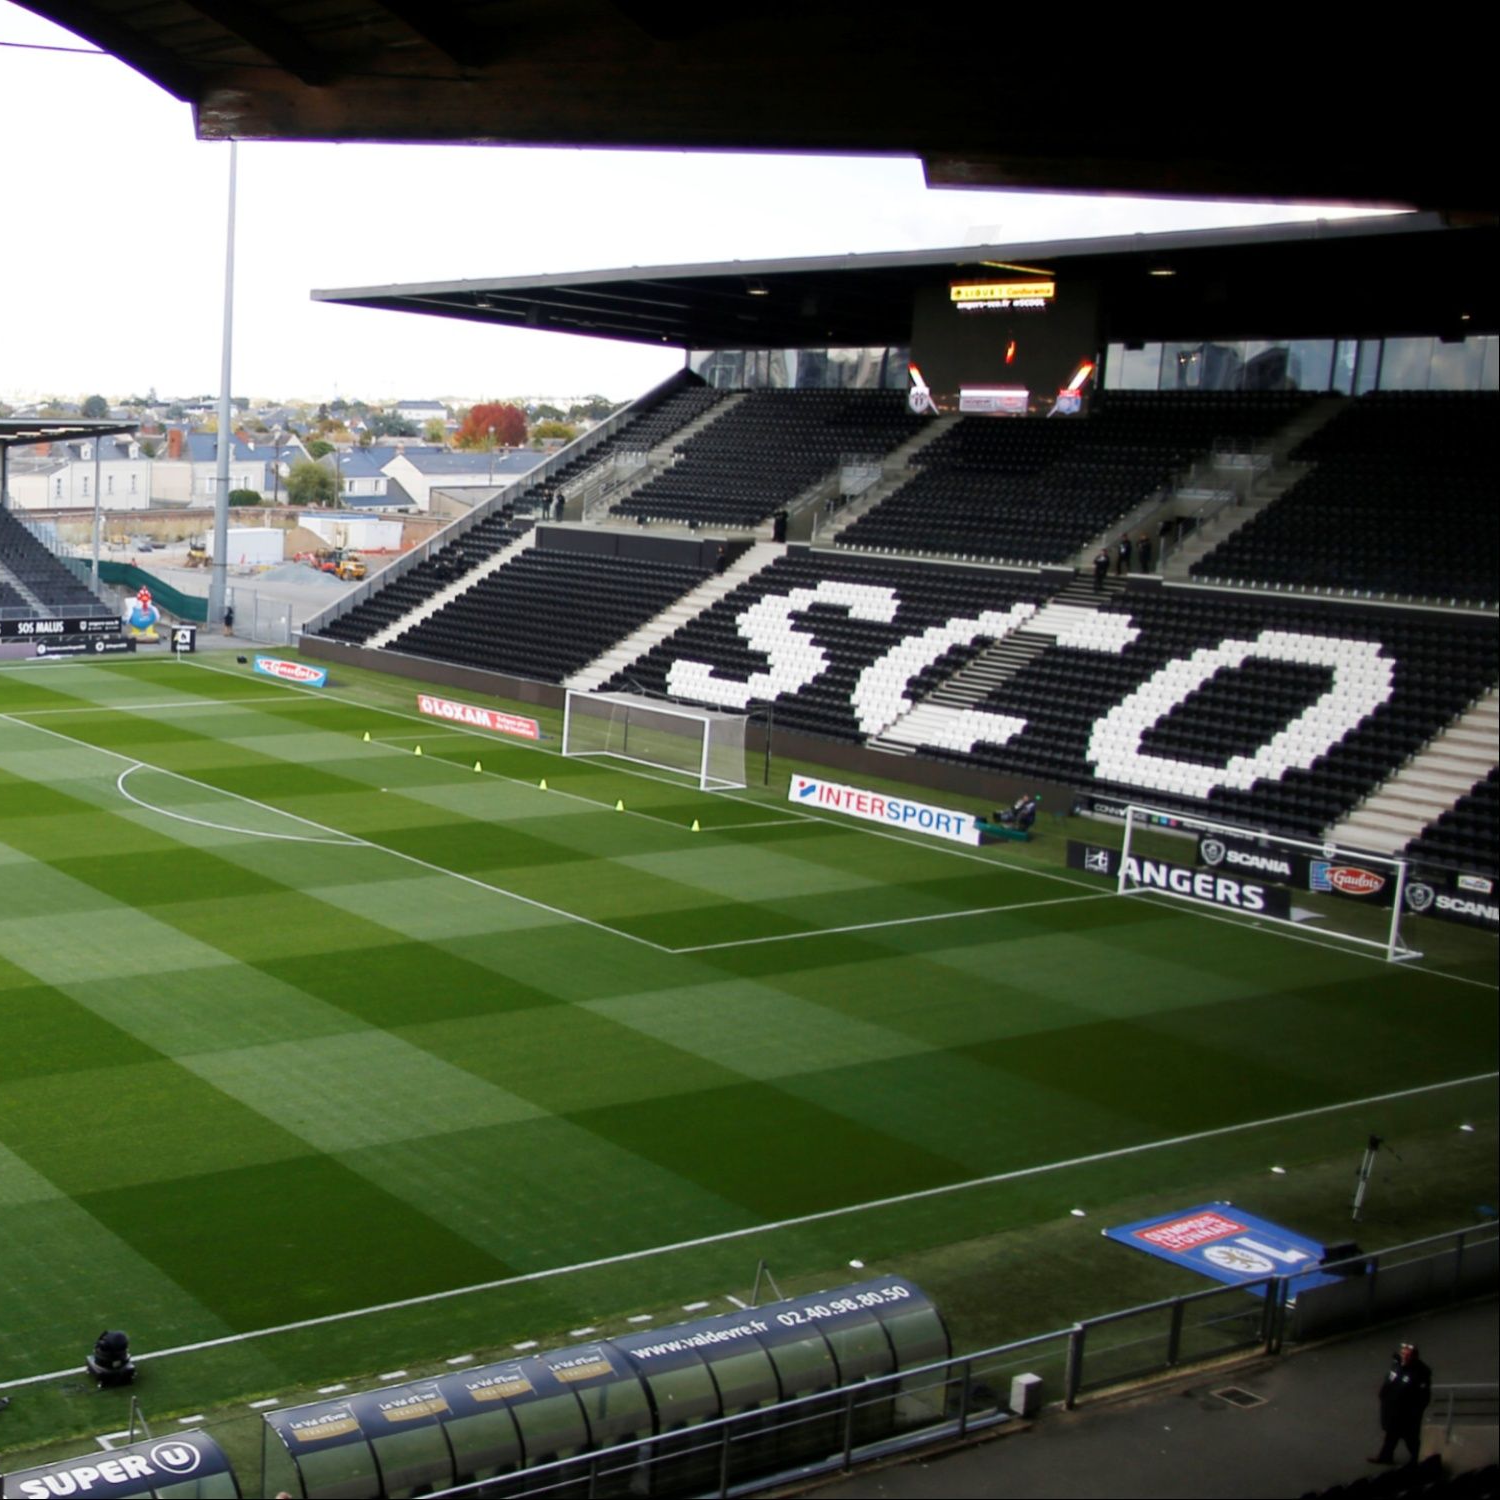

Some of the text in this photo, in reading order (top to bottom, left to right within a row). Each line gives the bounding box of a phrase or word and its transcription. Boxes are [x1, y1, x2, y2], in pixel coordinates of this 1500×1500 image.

[18, 620, 64, 635] SOS MALUS
[665, 580, 1396, 799] SCO
[433, 699, 493, 728] LOXAM
[819, 784, 966, 836] INTERSPORT
[1122, 856, 1265, 911] ANGERS
[1226, 849, 1292, 876] SCANIA
[1333, 869, 1381, 890] Gaulois
[631, 1285, 910, 1360] www.valdevre.fr 02.40.98.80.50
[19, 1454, 155, 1500] SUPER
